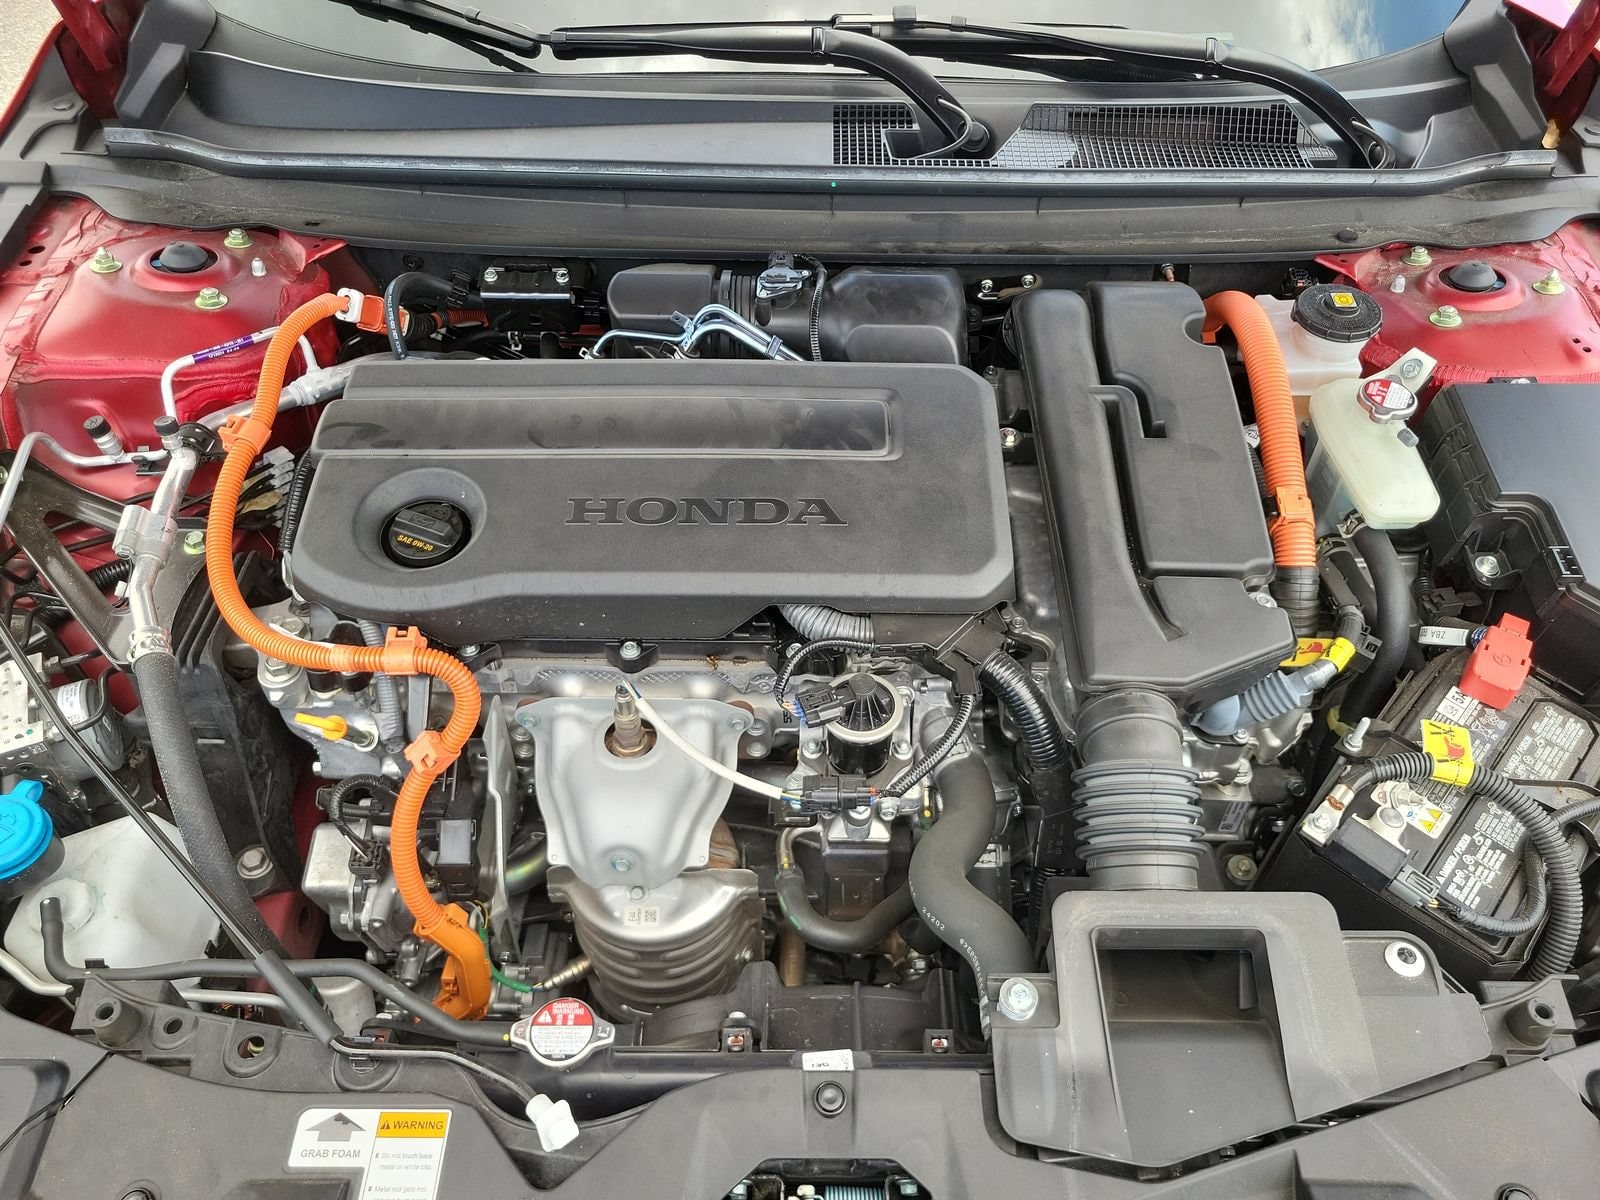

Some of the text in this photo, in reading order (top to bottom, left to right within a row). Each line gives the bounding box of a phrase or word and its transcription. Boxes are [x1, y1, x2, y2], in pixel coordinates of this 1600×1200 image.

[564, 497, 848, 526] HONDA
[397, 534, 434, 551] SAE 0W-20
[921, 906, 945, 931] 24202
[393, 1121, 444, 1130] WARNING
[300, 1149, 361, 1158] GRAB FOAM
